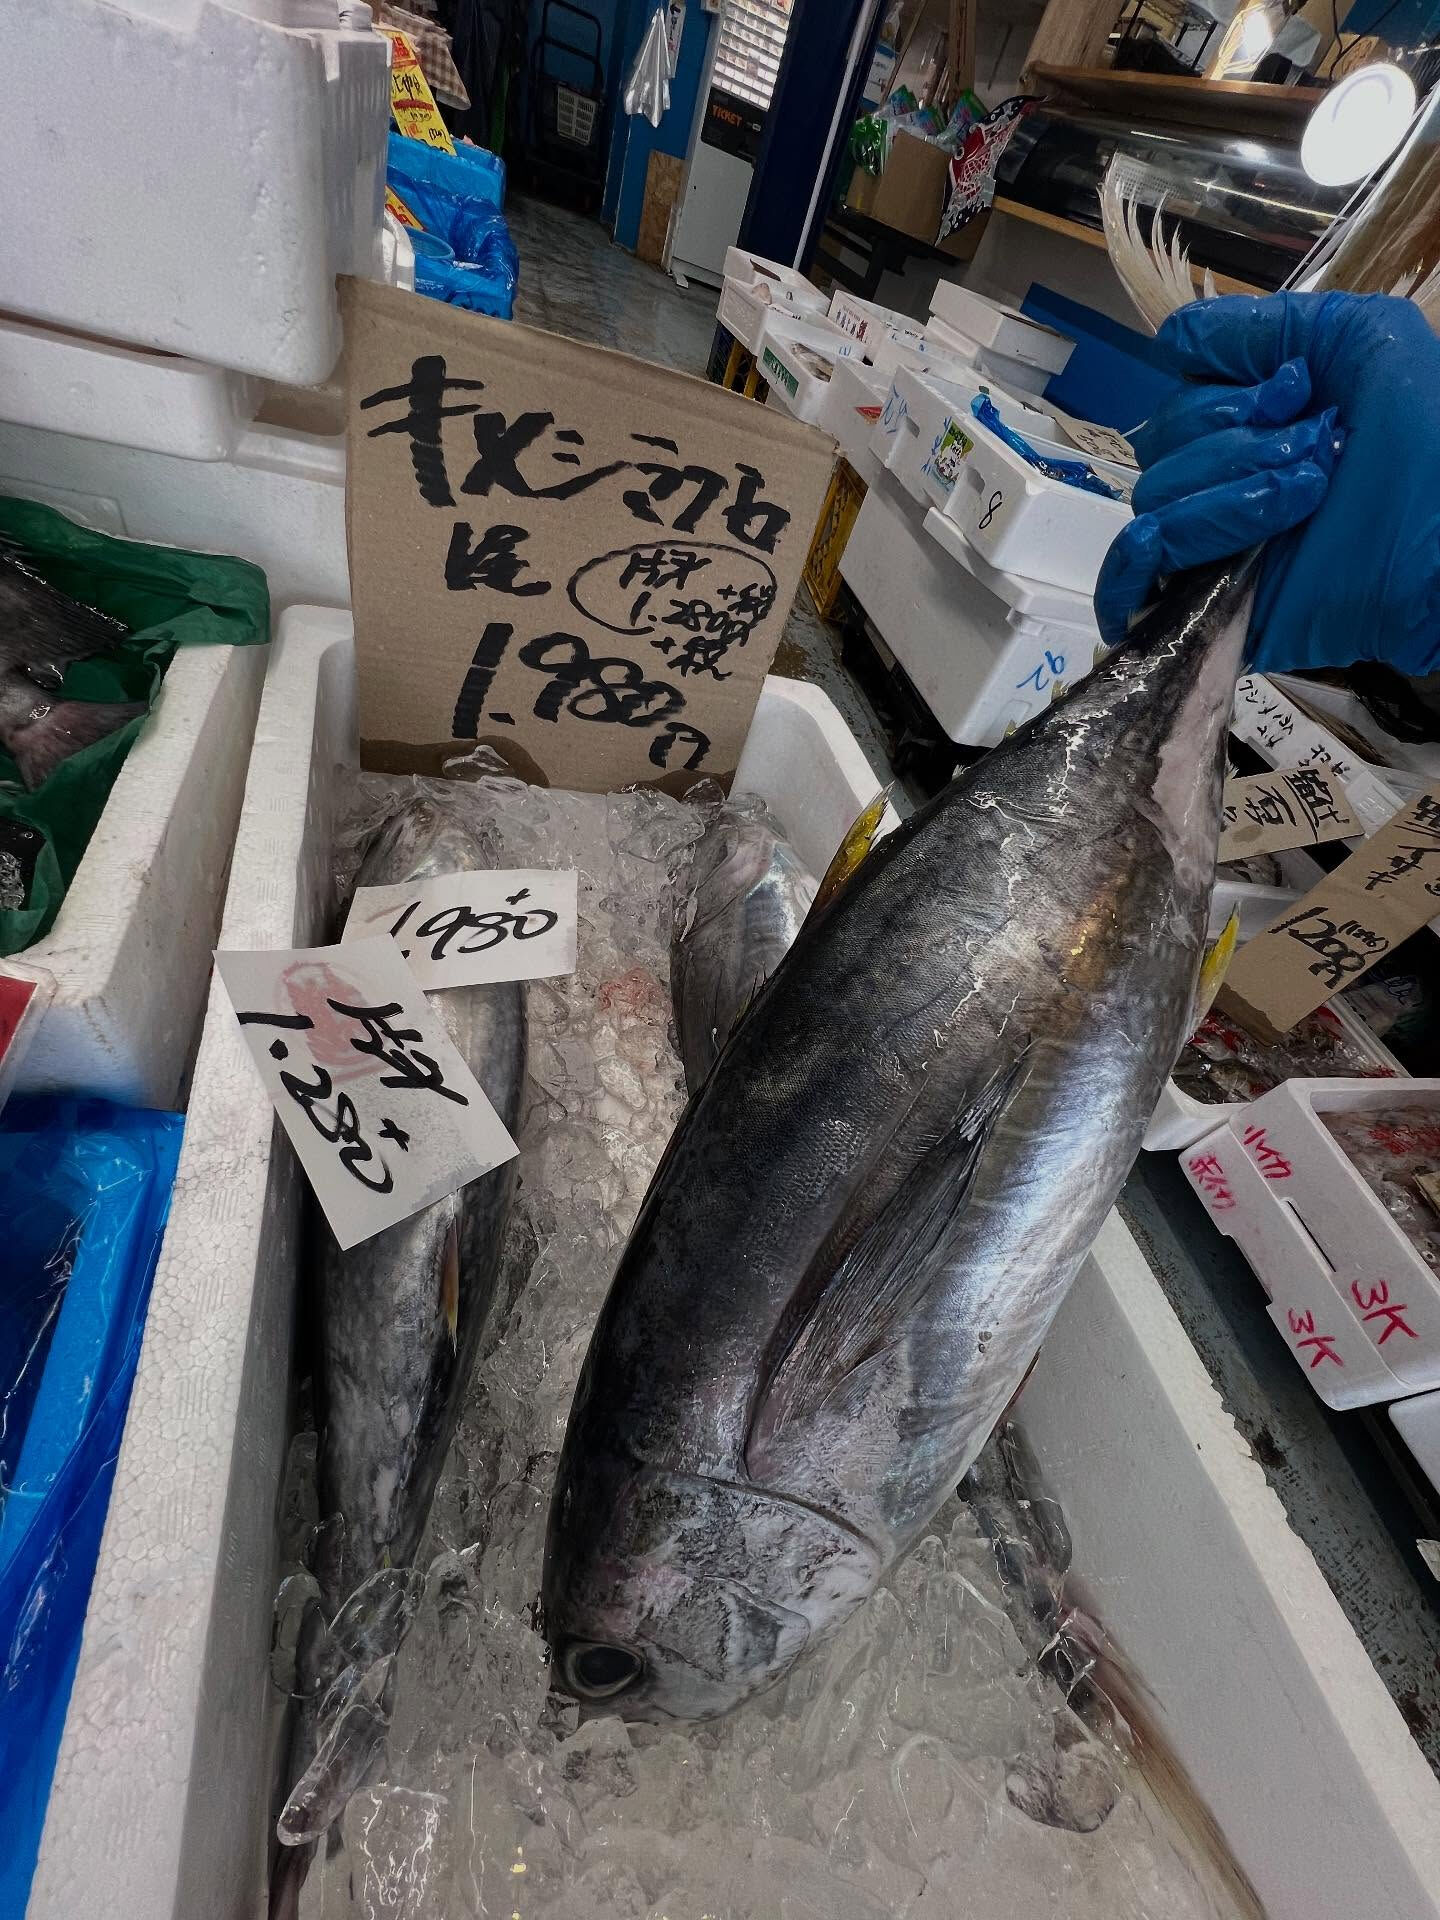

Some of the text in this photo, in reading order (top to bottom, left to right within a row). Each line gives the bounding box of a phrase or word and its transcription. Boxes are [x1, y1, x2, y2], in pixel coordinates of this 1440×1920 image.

[711, 104, 743, 128] TICKET
[1287, 1306, 1344, 1369] 3K
[1352, 1279, 1420, 1346] 3K
